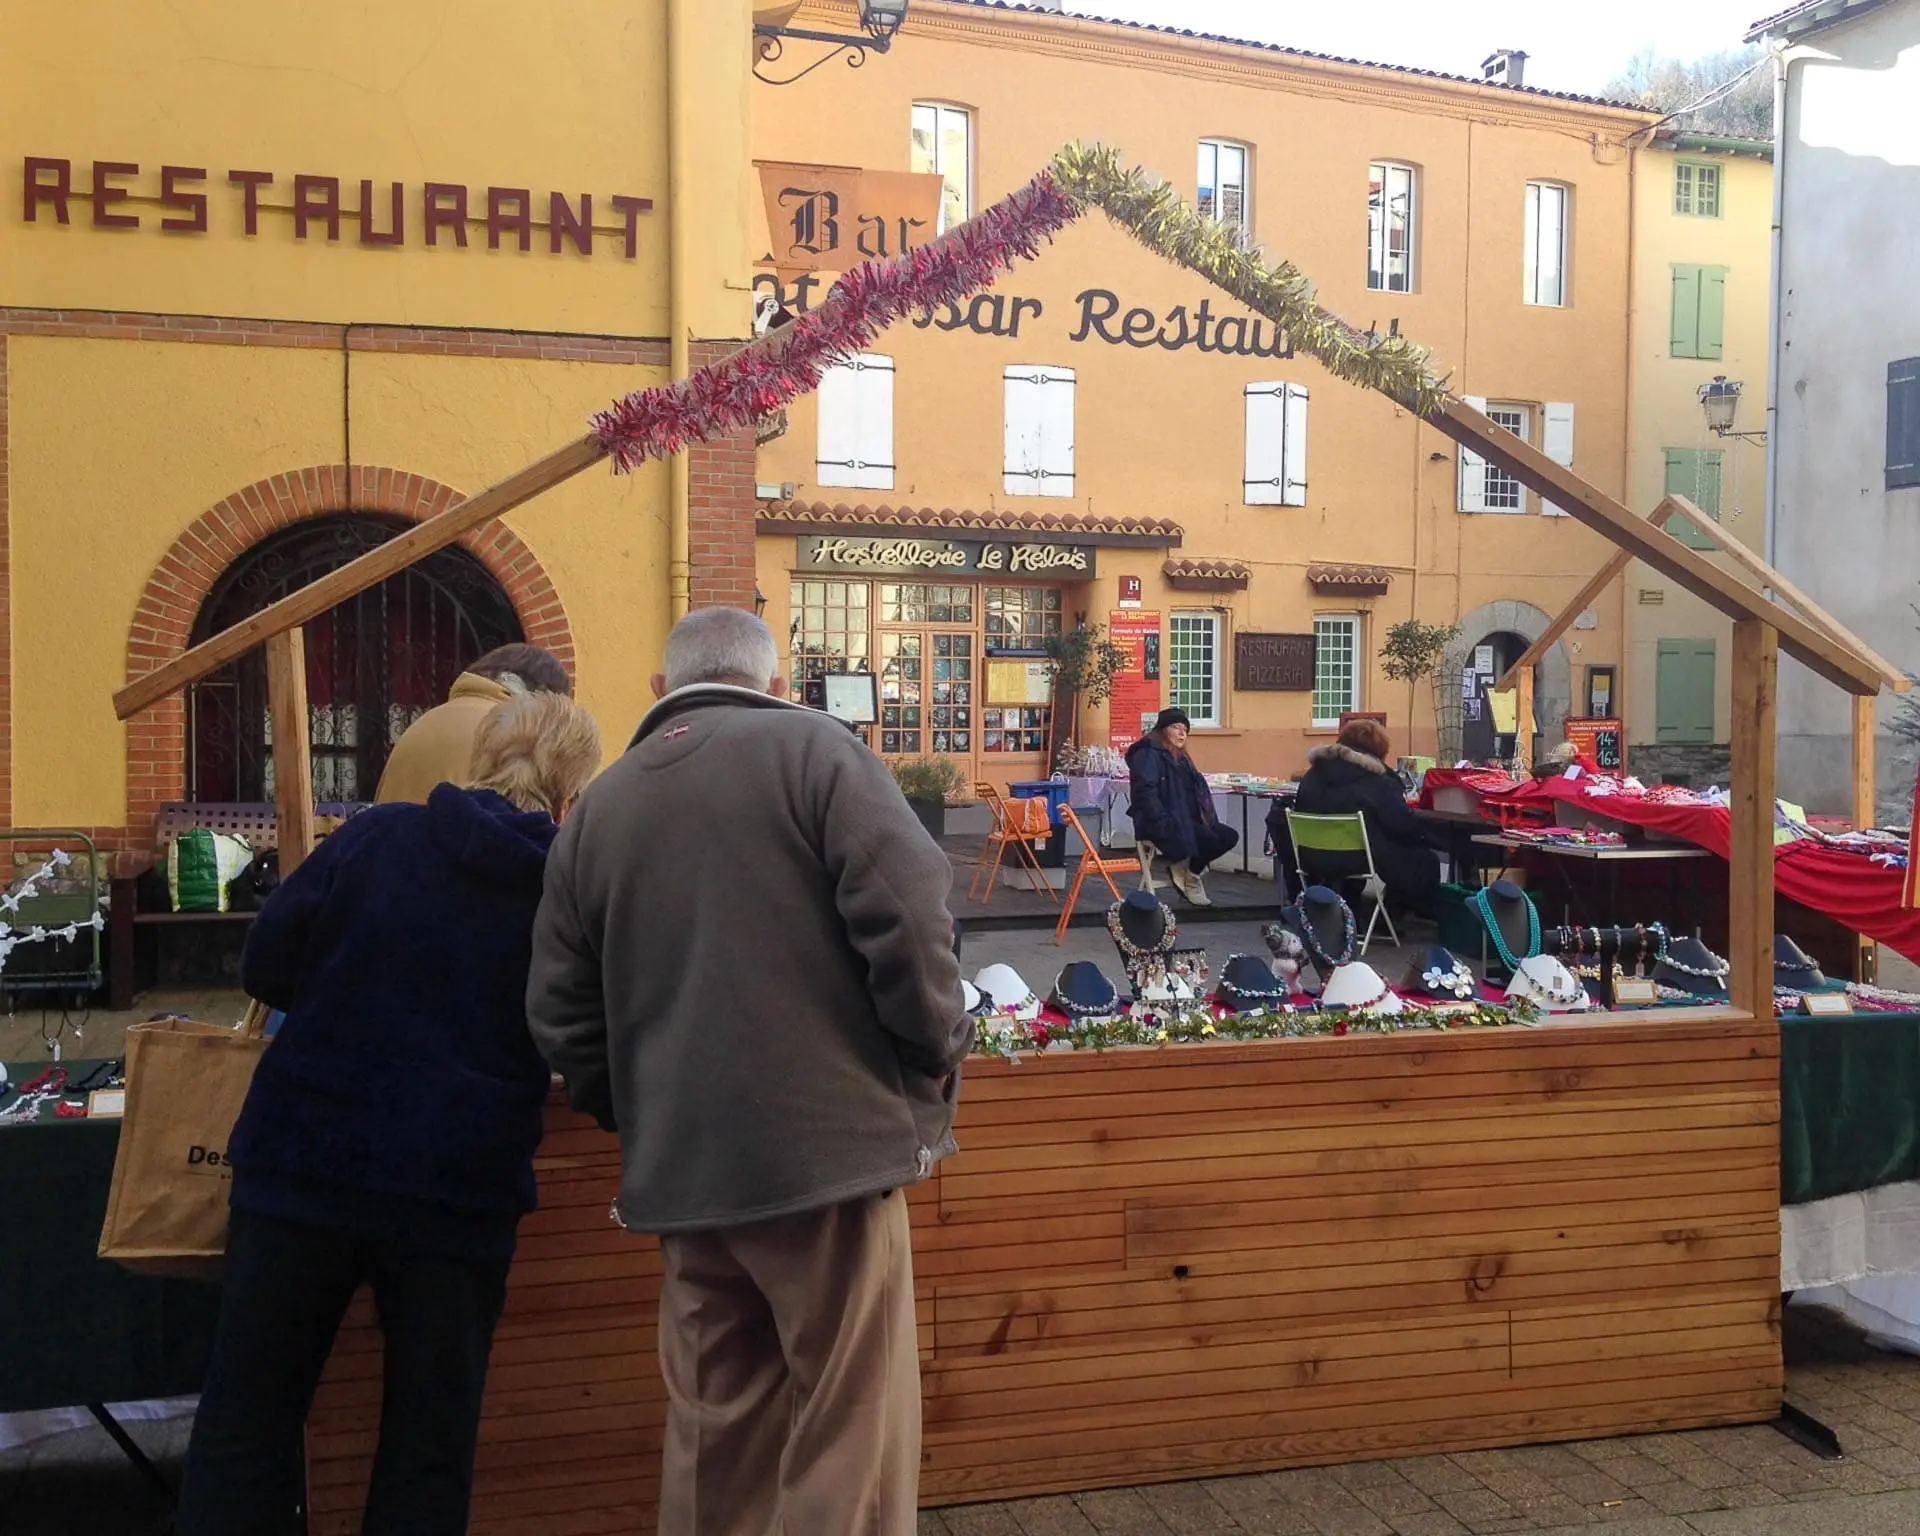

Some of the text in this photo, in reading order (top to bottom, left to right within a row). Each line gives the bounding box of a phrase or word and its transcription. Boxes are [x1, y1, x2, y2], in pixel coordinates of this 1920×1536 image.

[23, 156, 653, 259] RESTAURANT
[777, 187, 928, 258] Bar
[813, 539, 1088, 572] Hostellerie Le Relais
[1129, 579, 1140, 591] H
[1248, 665, 1304, 684] PIZZERIA
